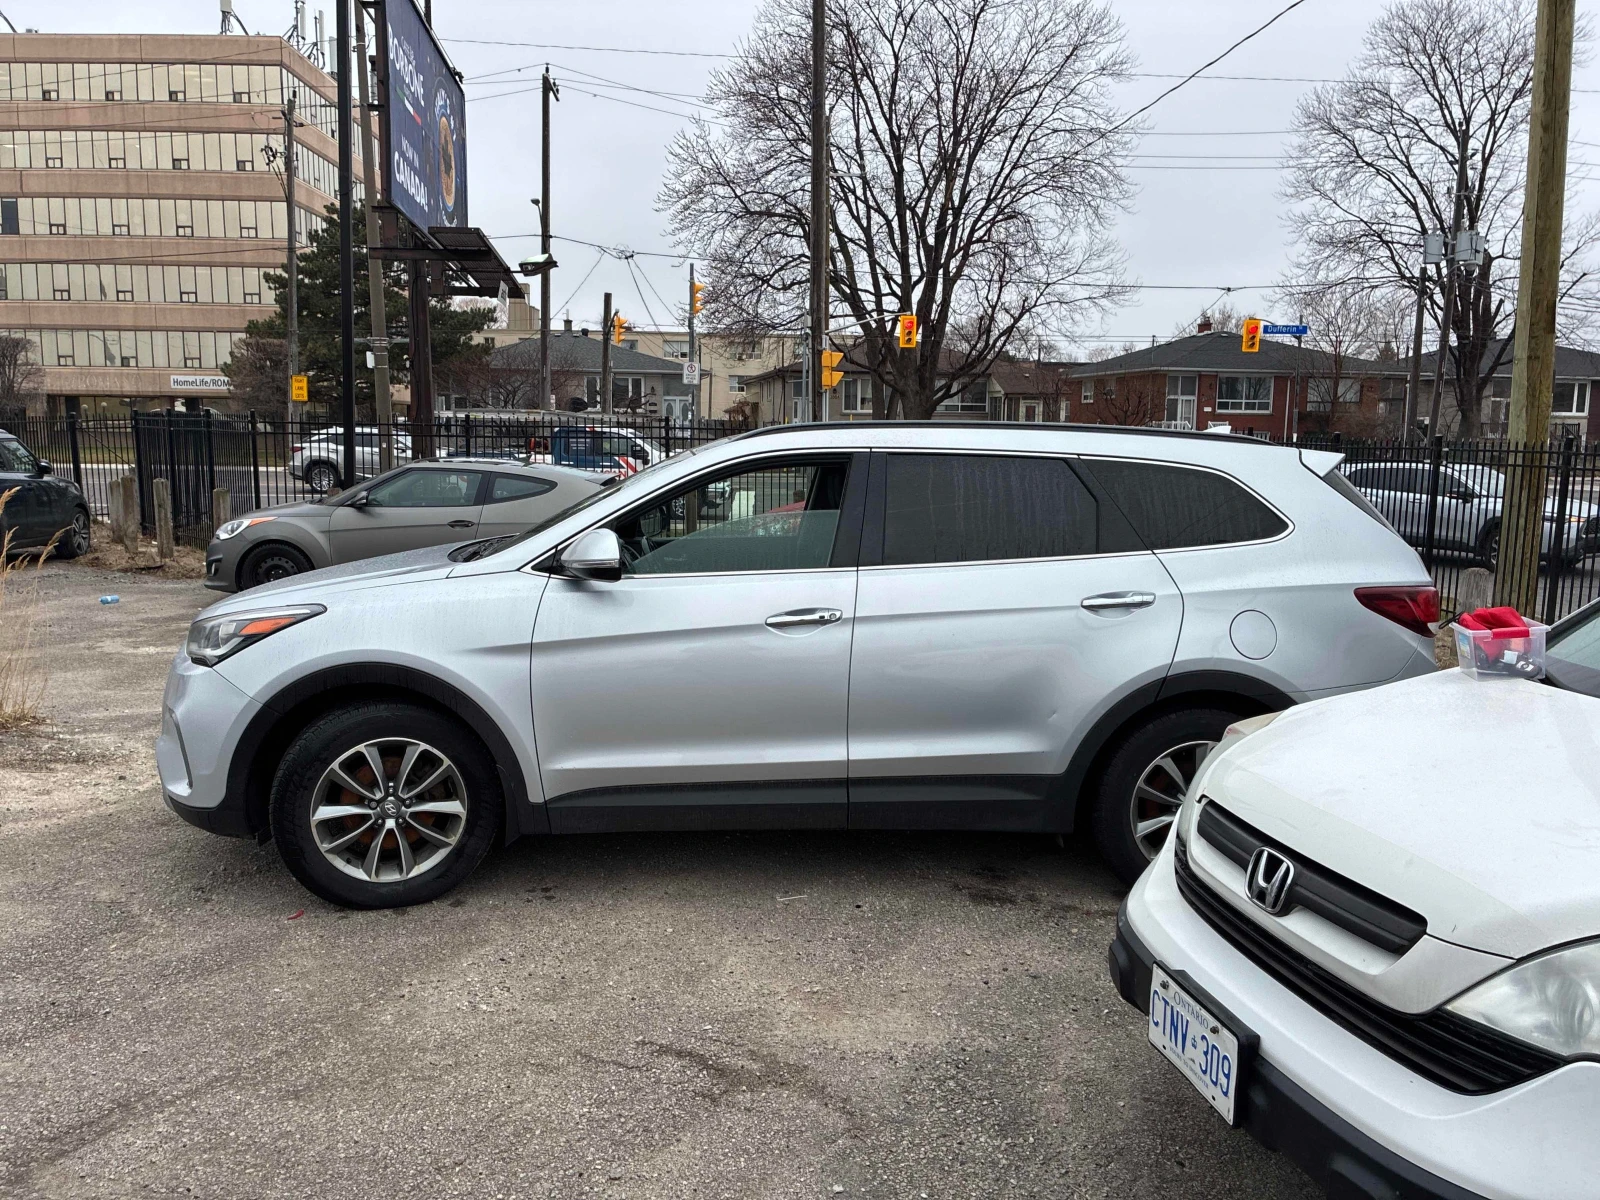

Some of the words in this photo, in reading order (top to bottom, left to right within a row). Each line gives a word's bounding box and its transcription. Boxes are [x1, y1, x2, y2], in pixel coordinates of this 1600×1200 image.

[401, 134, 413, 162] NOW
[394, 151, 428, 212] CANADA!
[1267, 325, 1297, 333] Dufferin
[1173, 991, 1209, 1030] ONTARIO
[1151, 989, 1190, 1055] CTNV
[1199, 1034, 1232, 1098] 309
